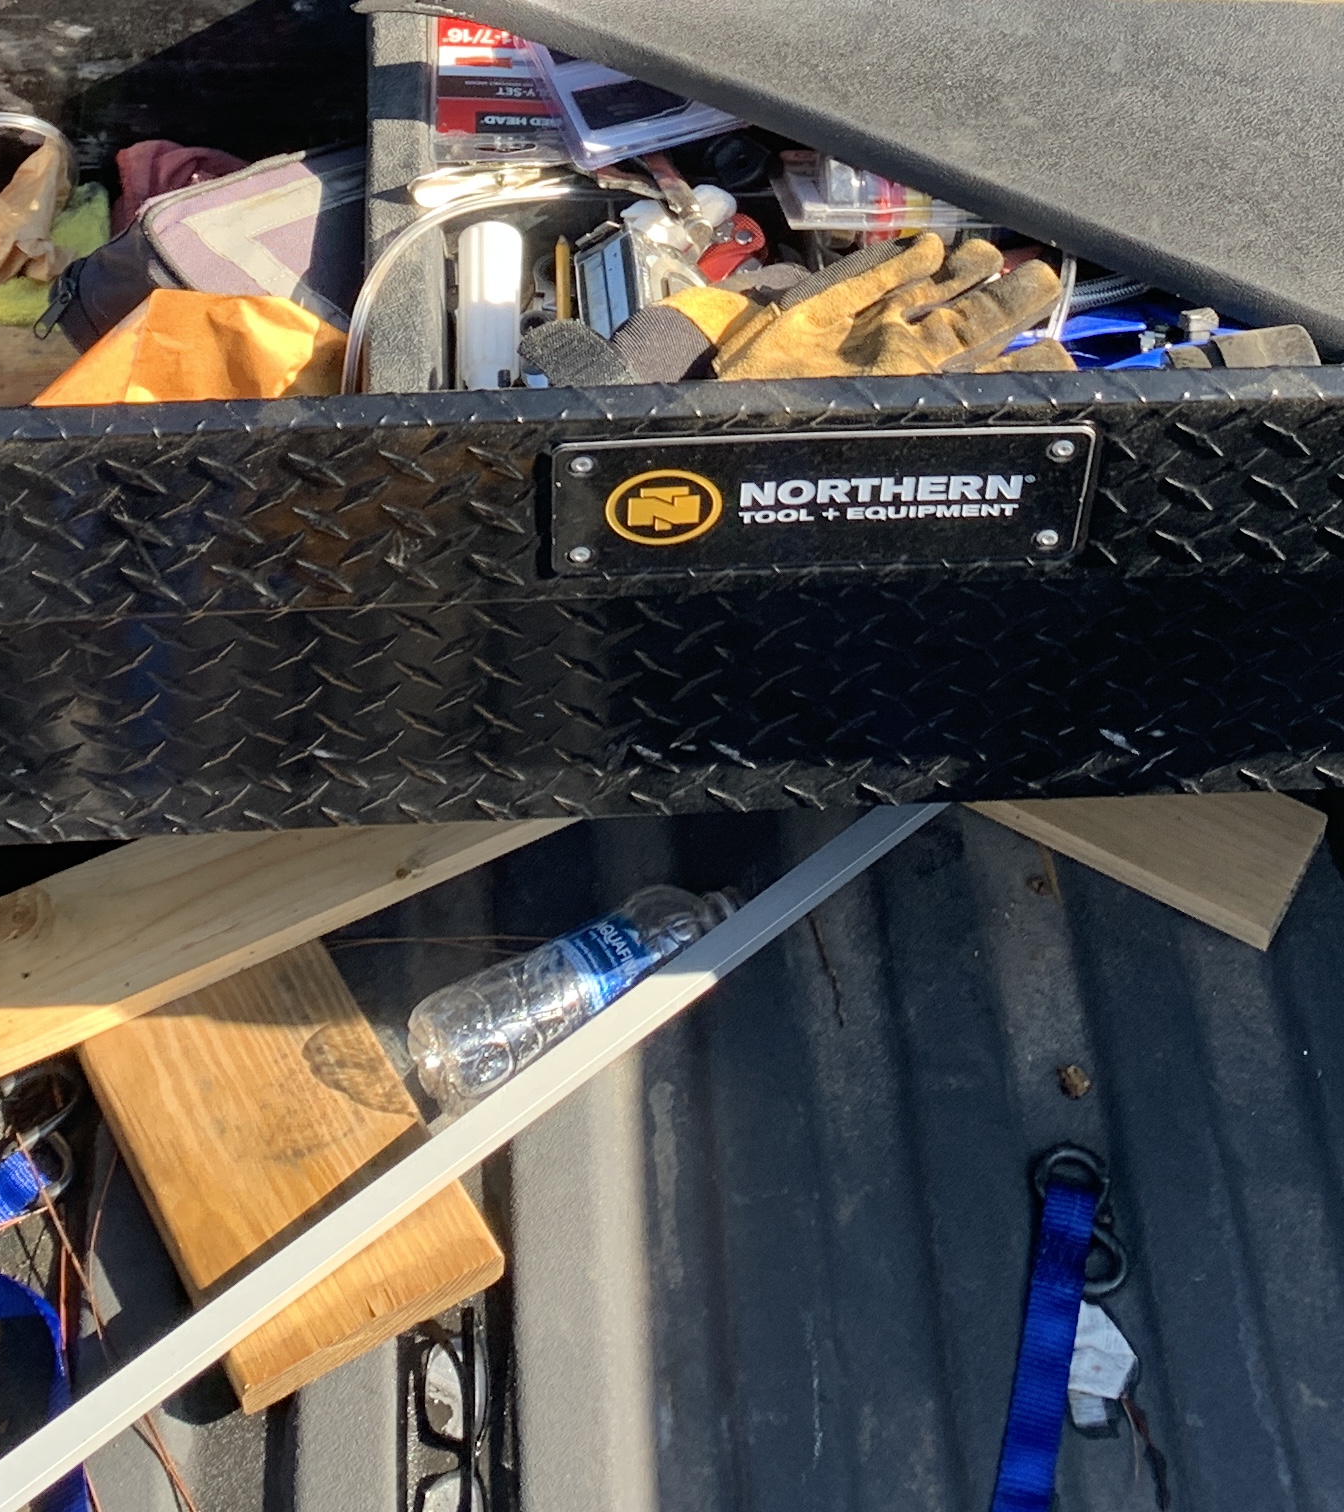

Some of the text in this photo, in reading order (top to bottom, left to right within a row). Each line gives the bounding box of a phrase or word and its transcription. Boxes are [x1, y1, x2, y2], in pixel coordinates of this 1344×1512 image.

[484, 115, 528, 126] HEAD
[739, 474, 1024, 508] NORTHERN
[738, 509, 815, 525] TOOL
[846, 503, 1019, 522] EQUIPMENT
[596, 921, 639, 979] AQUAFINA
